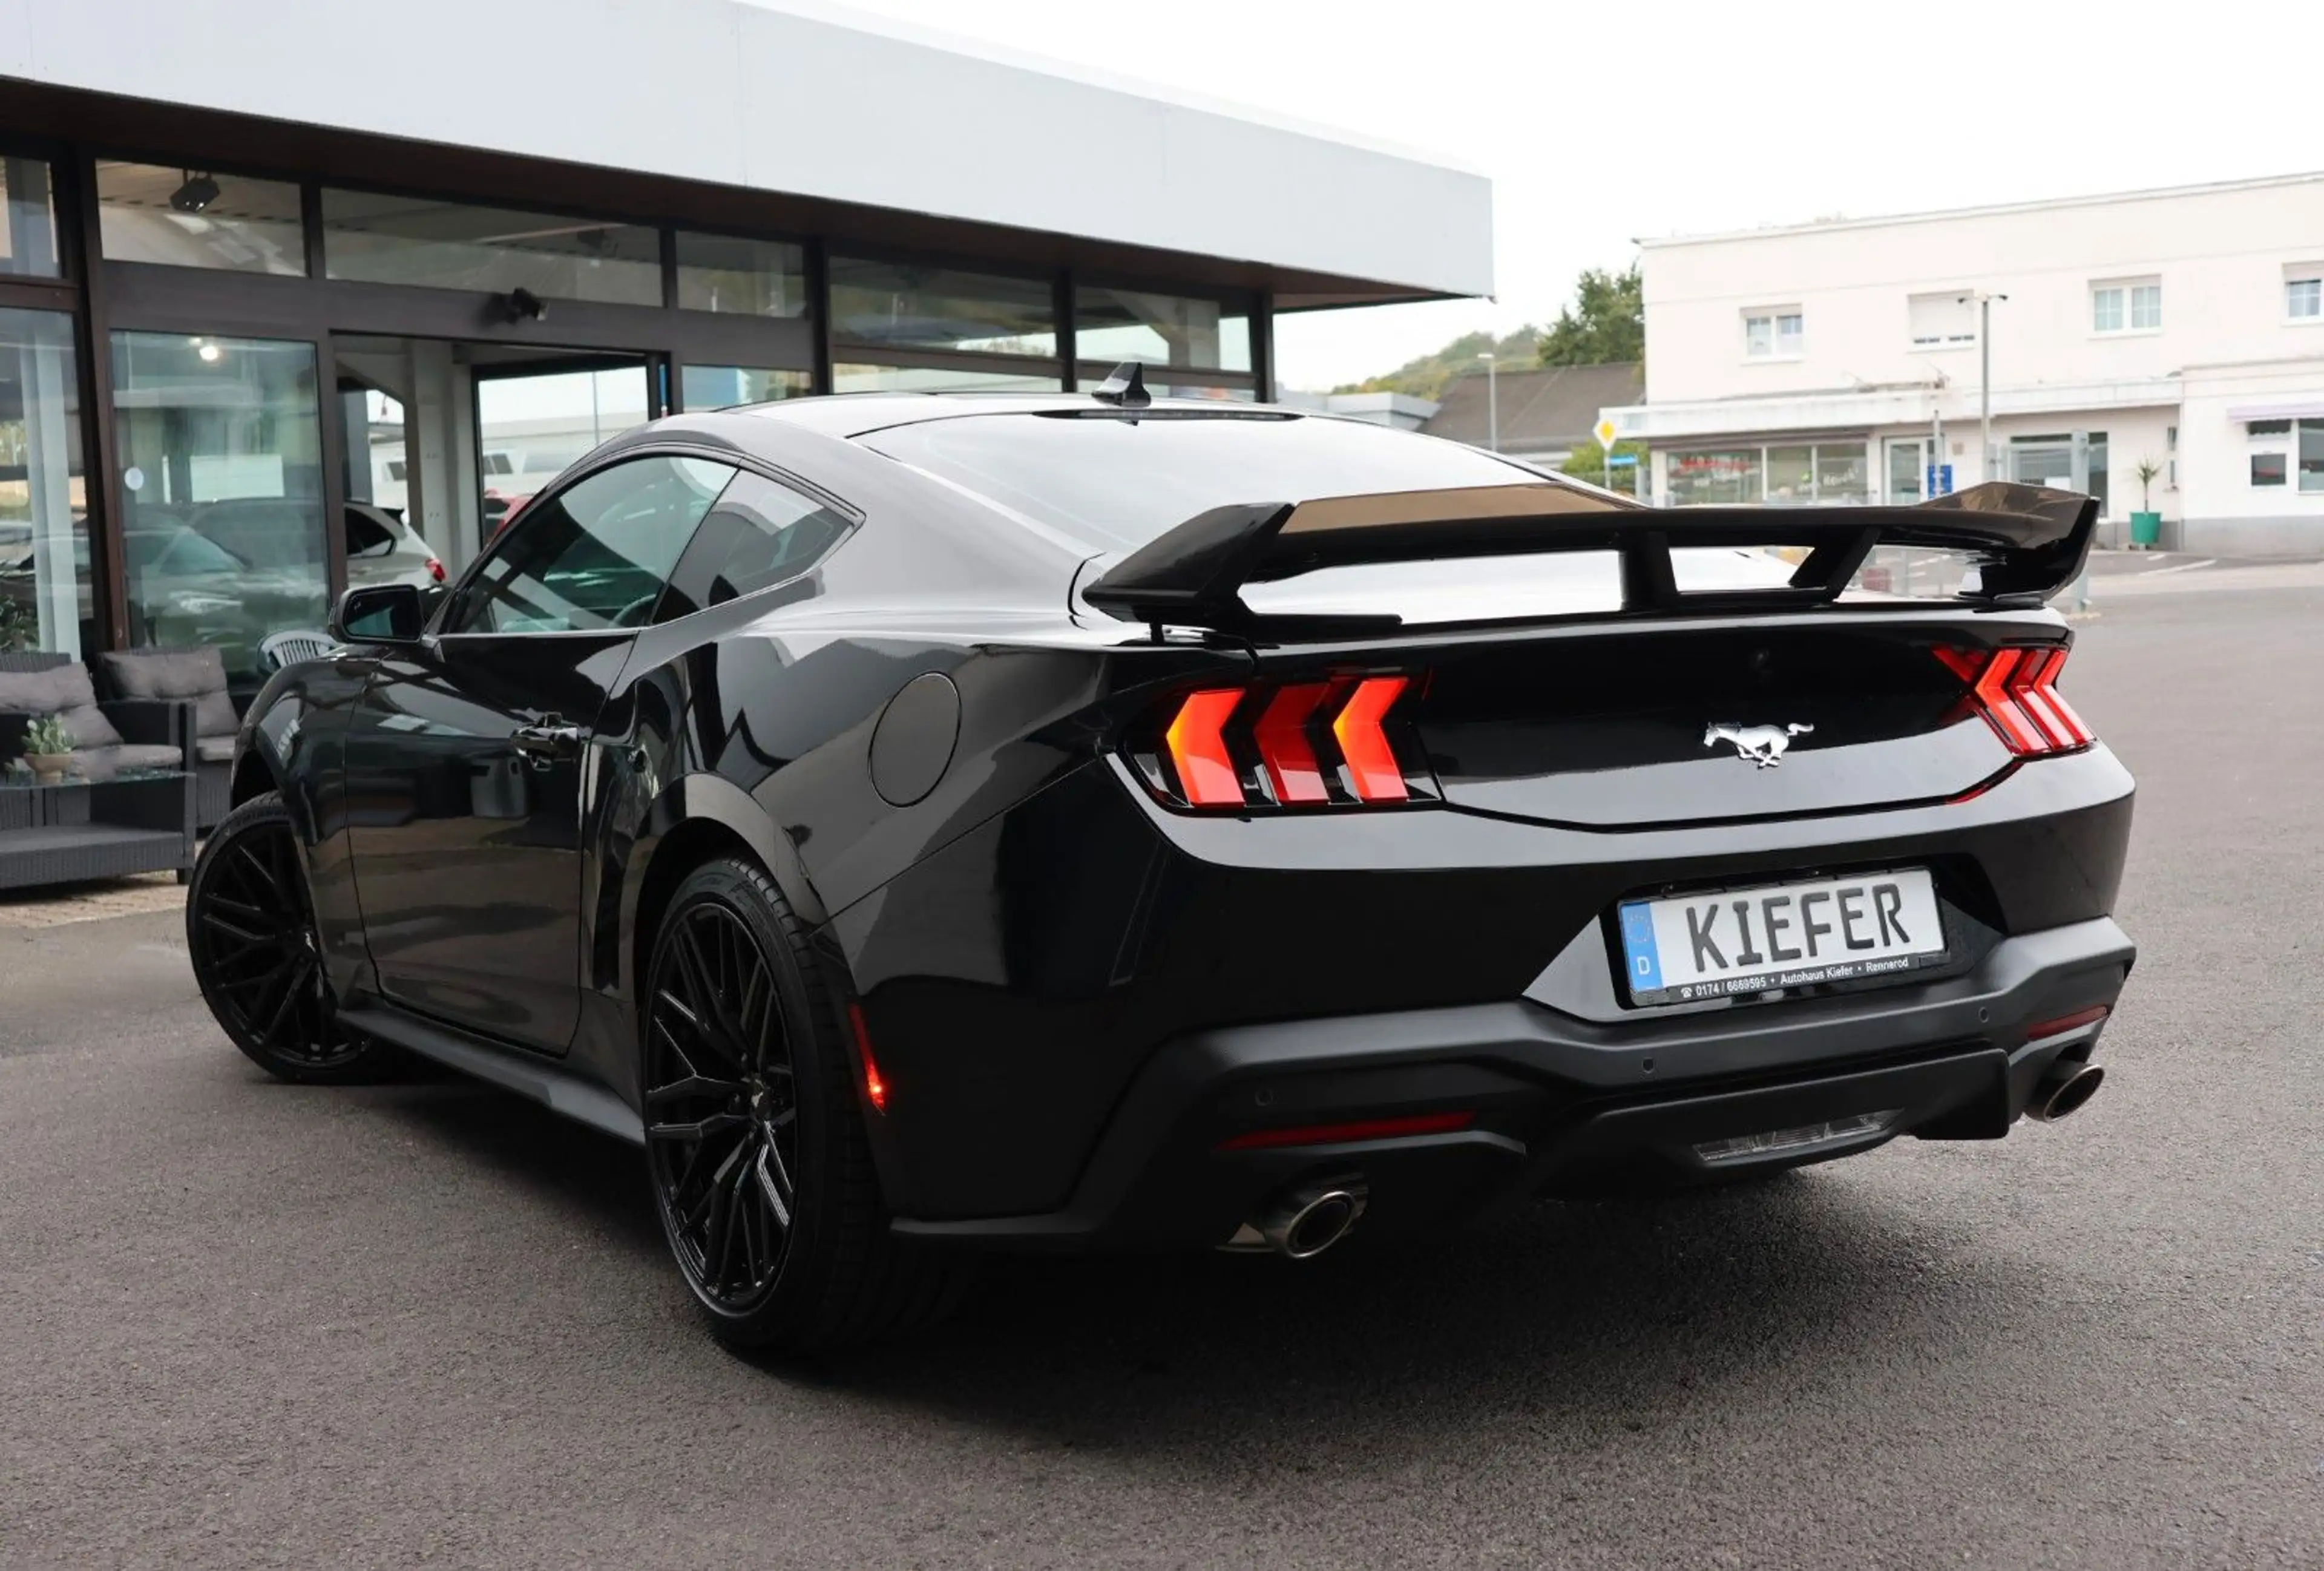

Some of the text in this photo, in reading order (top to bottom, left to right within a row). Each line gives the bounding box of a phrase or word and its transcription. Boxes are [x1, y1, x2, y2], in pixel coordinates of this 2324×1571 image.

[1686, 883, 1911, 972] KIEFER
[1636, 956, 1650, 975] D
[1696, 983, 1720, 996] 0174
[1780, 971, 1825, 985] Autohaus
[1826, 965, 1853, 978] Kiefer
[1866, 957, 1909, 972] Rennerod
